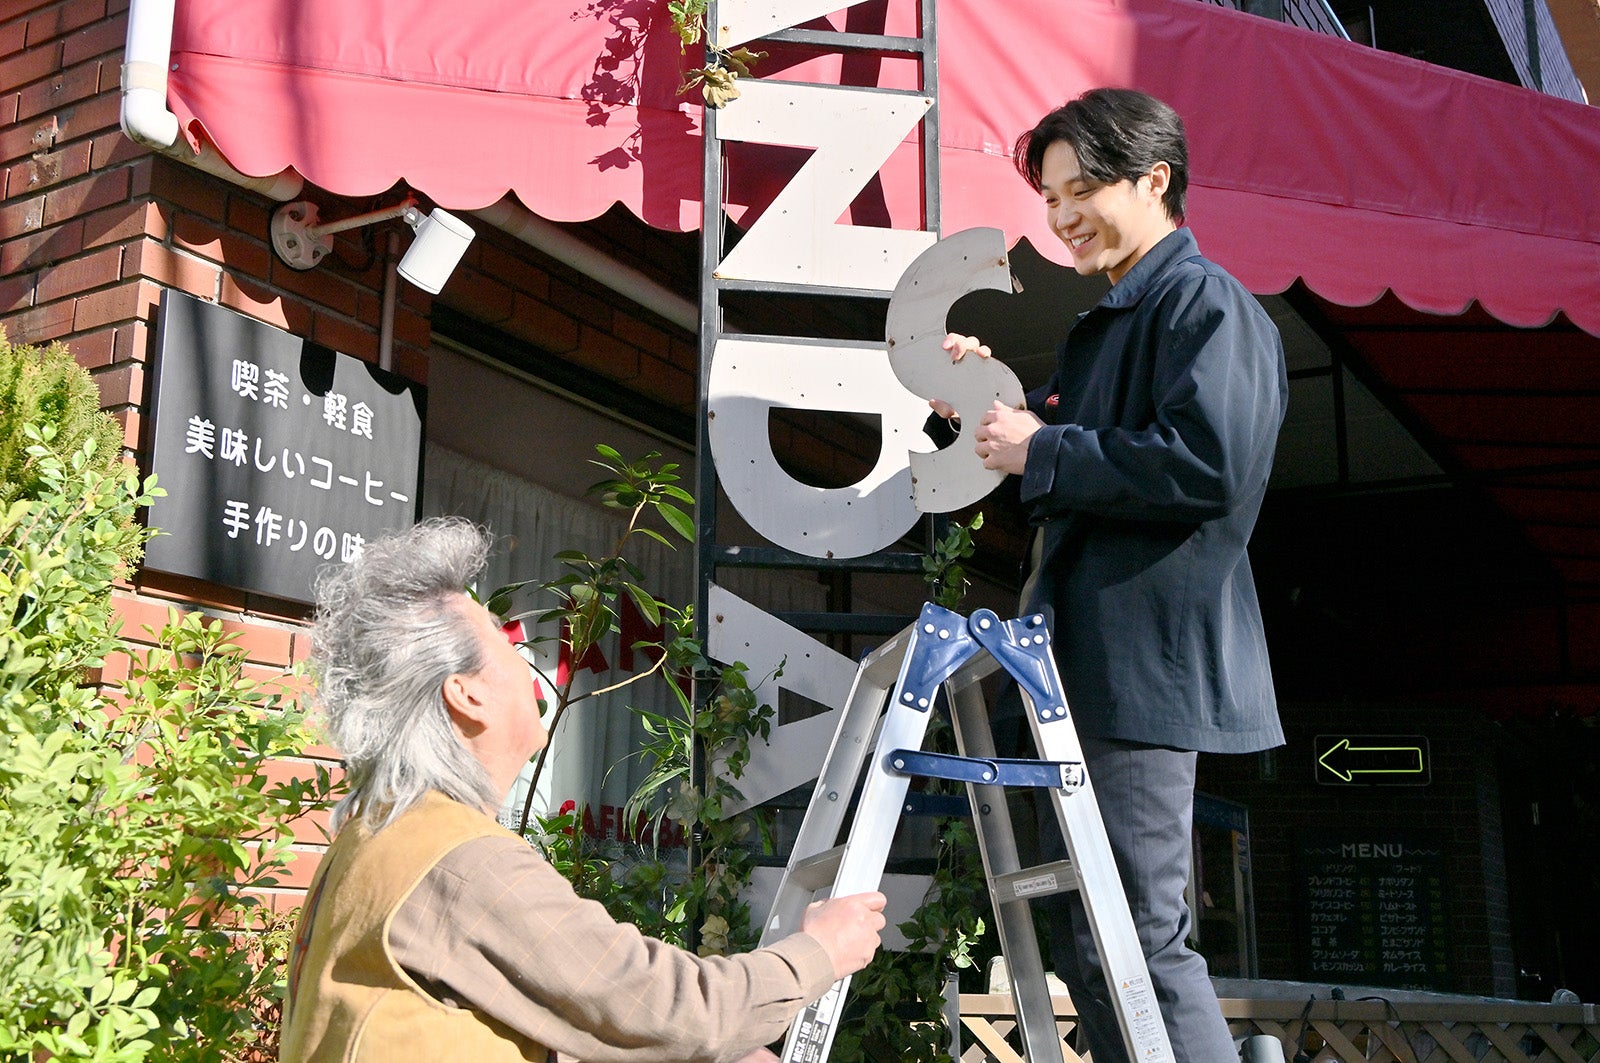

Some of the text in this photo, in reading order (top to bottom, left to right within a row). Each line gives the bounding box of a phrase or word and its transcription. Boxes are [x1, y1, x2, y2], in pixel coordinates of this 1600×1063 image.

[231, 359, 375, 440] 喫茶・軽食
[885, 227, 1026, 513] S
[184, 415, 409, 506] 美味しいコーヒー
[222, 499, 367, 564] 手作りの味
[1341, 843, 1403, 859] MENU
[1311, 925, 1337, 934] ココア
